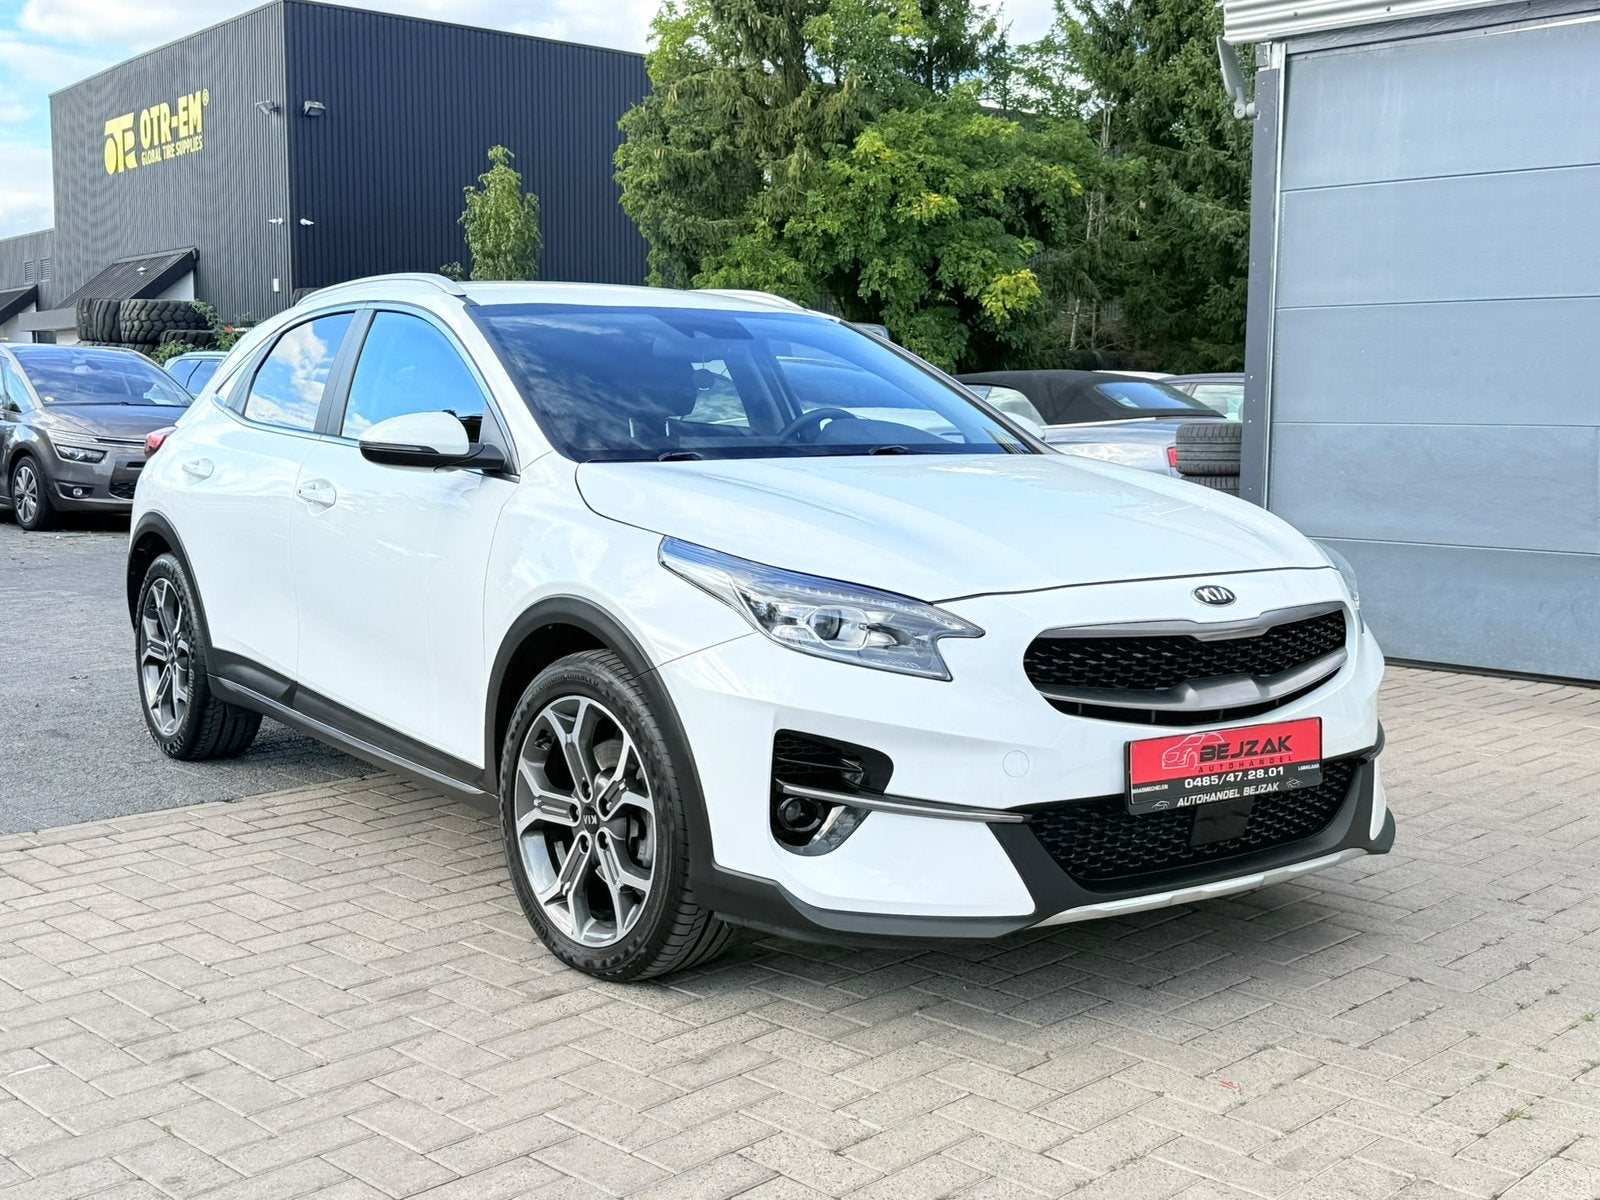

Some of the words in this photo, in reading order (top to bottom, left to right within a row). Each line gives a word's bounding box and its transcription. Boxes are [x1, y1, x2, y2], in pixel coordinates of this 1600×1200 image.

[142, 147, 162, 166] GLOBAL
[175, 135, 203, 156] SUPPLIES
[1197, 587, 1233, 601] KIA
[1199, 735, 1292, 763] BEJZAK
[1198, 755, 1292, 774] AUTOHANDEL
[1184, 766, 1284, 789] 0485/47.28.01
[1176, 787, 1240, 808] AUTOHANDEL
[1243, 781, 1280, 797] BEJZAK
